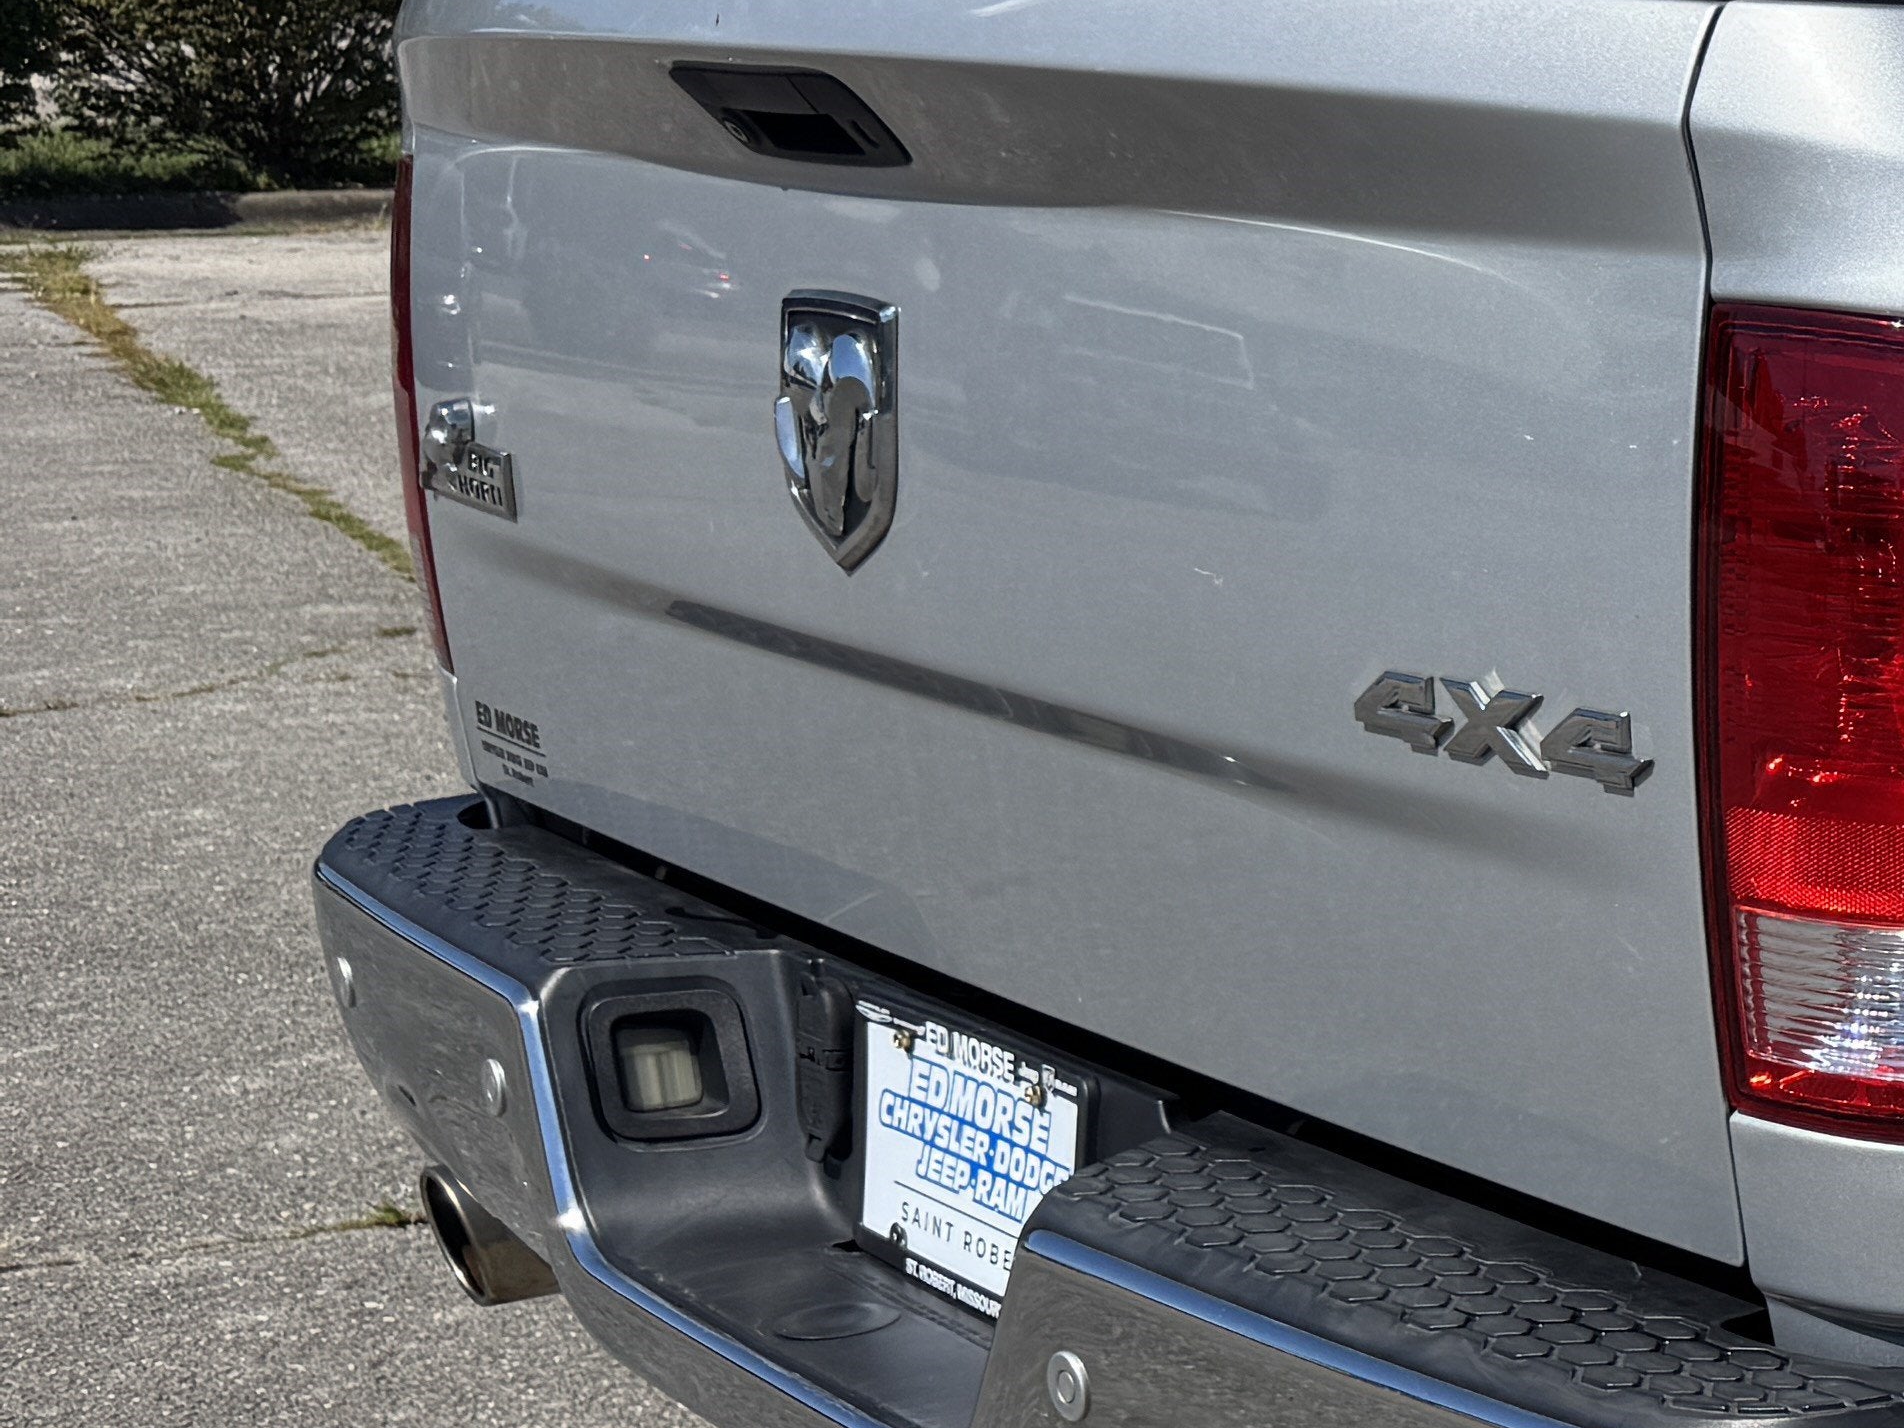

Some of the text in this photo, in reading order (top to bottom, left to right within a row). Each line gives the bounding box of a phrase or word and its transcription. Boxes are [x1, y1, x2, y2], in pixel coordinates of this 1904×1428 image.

[475, 700, 541, 750] ED MORSE
[1353, 670, 1656, 798] 4X4
[924, 1020, 949, 1056] ED
[952, 1030, 1015, 1086] MORSE
[910, 1058, 1052, 1156] ED MORSE
[901, 1201, 1012, 1272] SAINT ROBE
[957, 1282, 1003, 1320] MISSOUR
